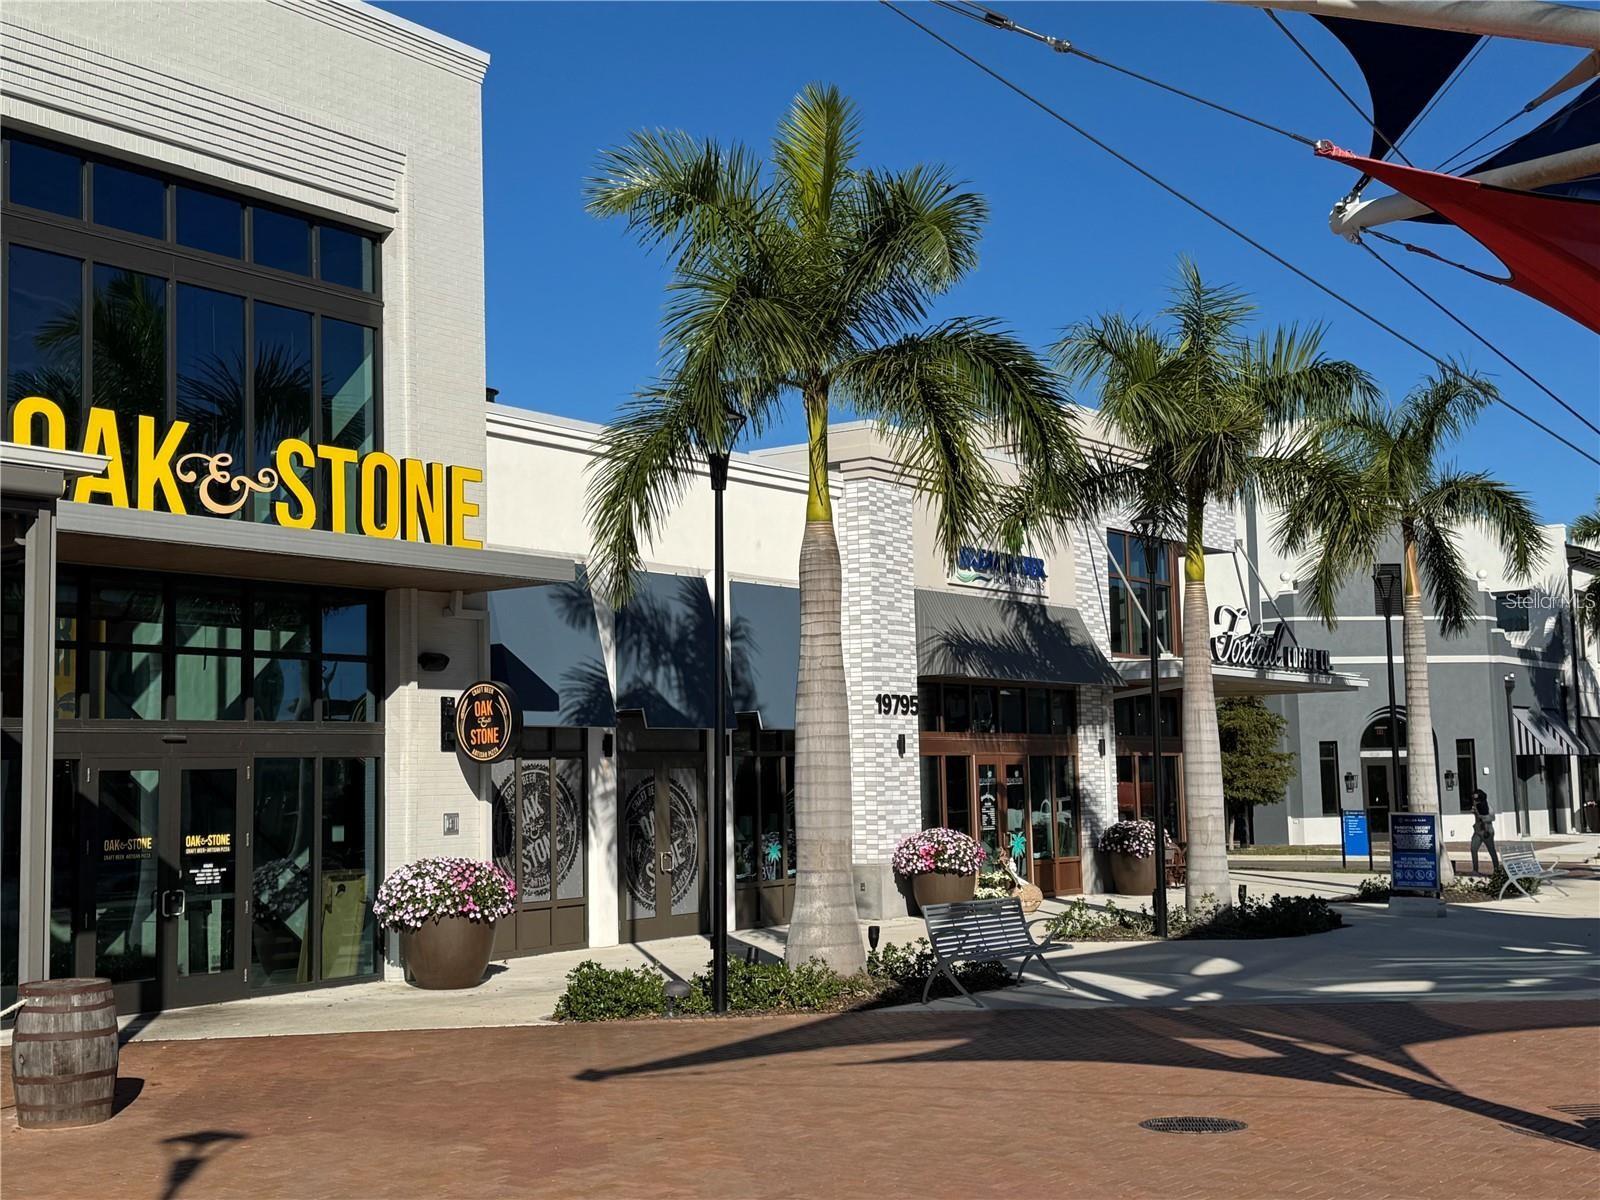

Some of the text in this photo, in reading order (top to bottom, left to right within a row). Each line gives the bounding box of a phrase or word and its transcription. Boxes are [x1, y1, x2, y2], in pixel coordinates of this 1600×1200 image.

[176, 452, 279, 514] &
[275, 438, 483, 548] STONE
[1210, 605, 1284, 667] Foxtail
[474, 699, 493, 717] OAK
[875, 694, 919, 716] 19795
[470, 727, 499, 746] STONE
[521, 791, 544, 824] AK
[104, 839, 120, 851] OAK
[128, 837, 152, 850] STONE
[186, 835, 201, 847] OAK
[208, 833, 231, 846] STONE
